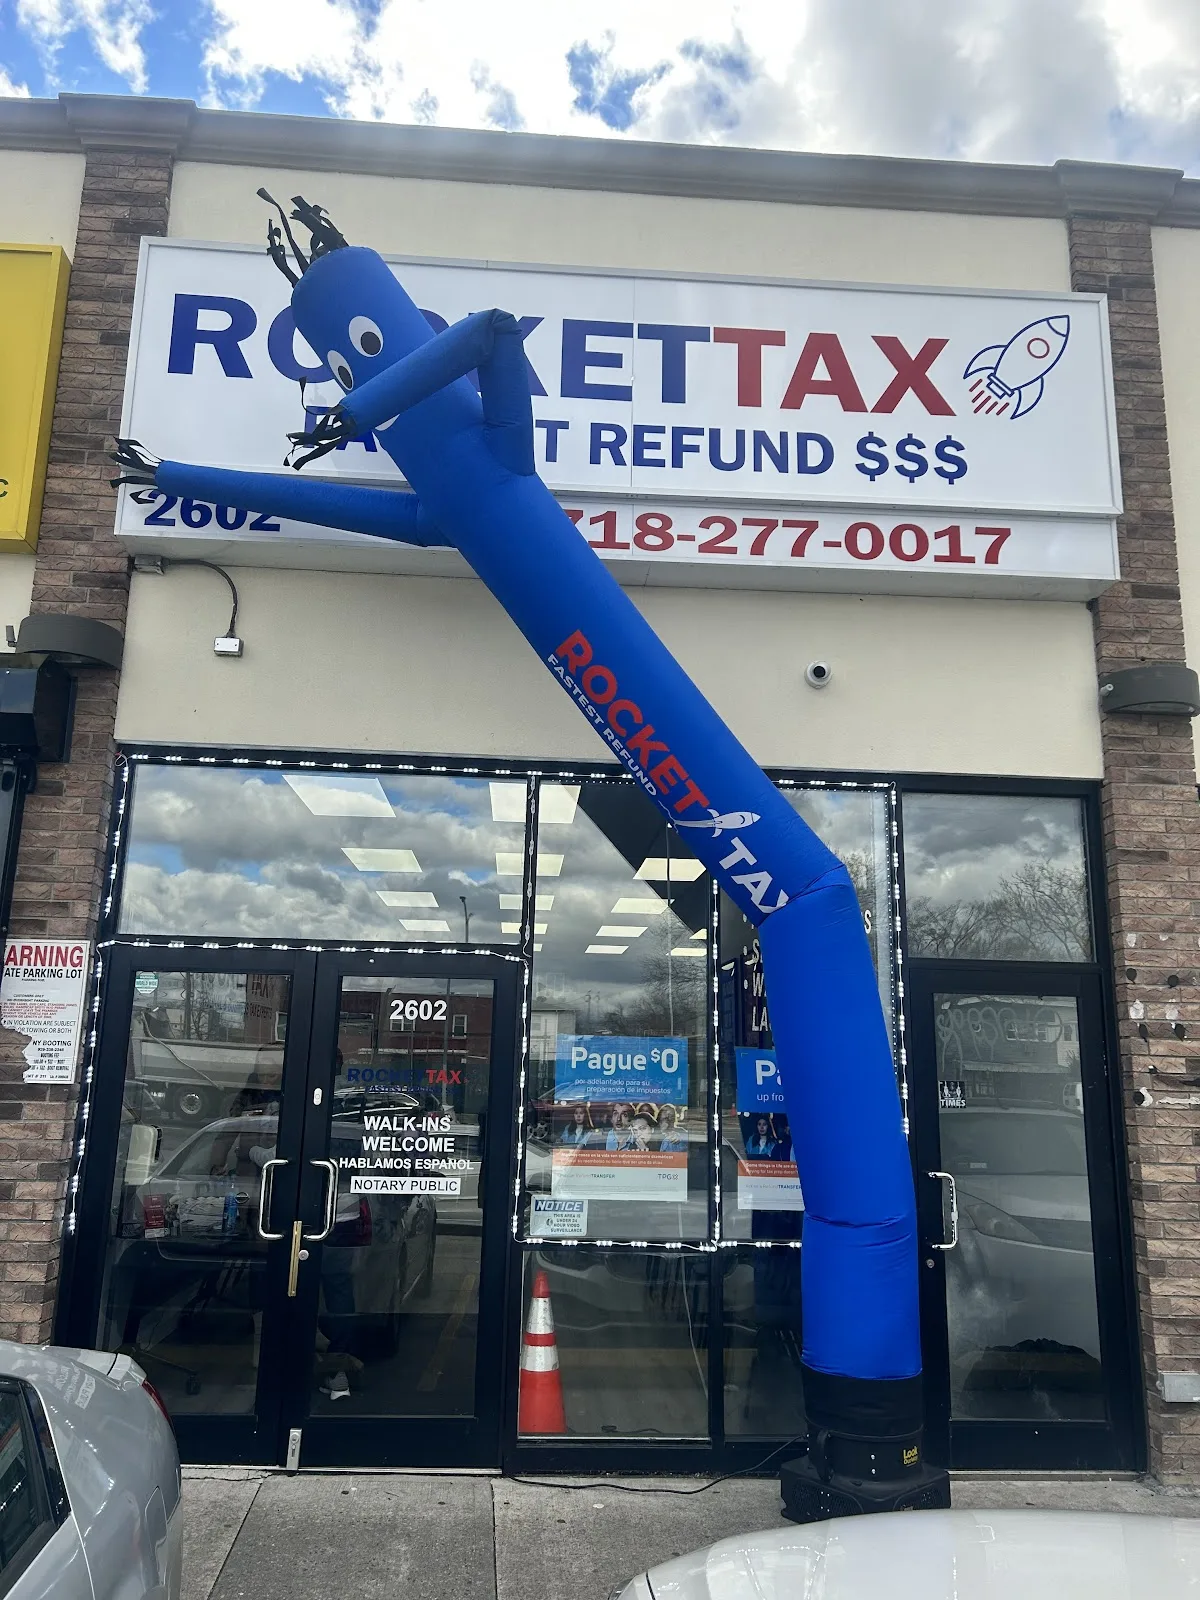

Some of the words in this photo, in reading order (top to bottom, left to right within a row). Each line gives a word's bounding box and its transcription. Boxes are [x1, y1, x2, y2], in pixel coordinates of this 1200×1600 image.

[588, 420, 835, 475] REFUND
[855, 431, 969, 486] $$$
[547, 653, 604, 725] FASTEST
[603, 728, 657, 796] REFUND
[555, 629, 710, 813] ROCKET
[23, 968, 63, 978] PARKING
[66, 969, 83, 979] LOT
[389, 999, 448, 1021] 2602
[571, 1046, 647, 1076] Pague
[650, 1047, 679, 1073] $0
[587, 1078, 625, 1086] adelantado
[636, 1087, 671, 1095] impuestos
[756, 1094, 769, 1103] up
[940, 1098, 966, 1108] TIMES
[364, 1115, 451, 1132] WALK-INS
[362, 1136, 455, 1153] WELCOME
[339, 1157, 412, 1170] HABLAMOS
[354, 1179, 408, 1191] NOTARY
[410, 1180, 458, 1192] PUBLIC
[536, 1200, 582, 1211] NOTICE
